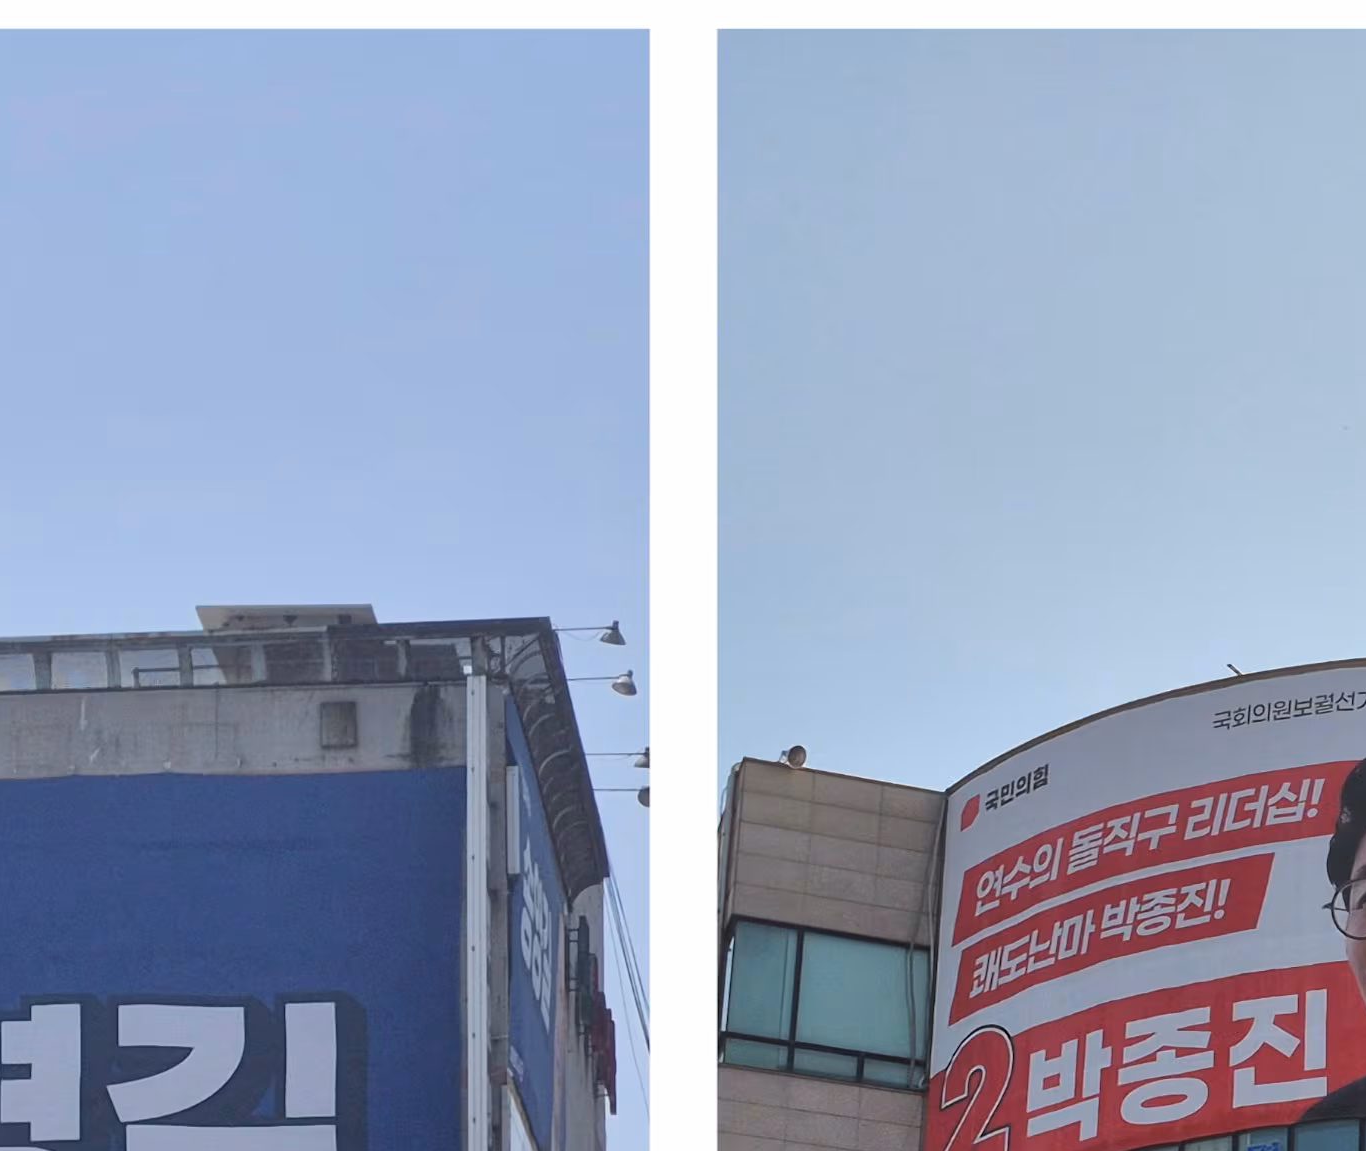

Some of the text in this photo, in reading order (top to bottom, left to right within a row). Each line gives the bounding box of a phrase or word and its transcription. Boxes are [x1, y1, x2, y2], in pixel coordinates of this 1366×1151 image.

[974, 779, 1327, 917] 연수의 돌직구 리더십!
[985, 764, 1050, 812] 국민의힘
[969, 878, 1232, 1000] 쾌도난마 박종진!
[1026, 988, 1329, 1143] 박종진
